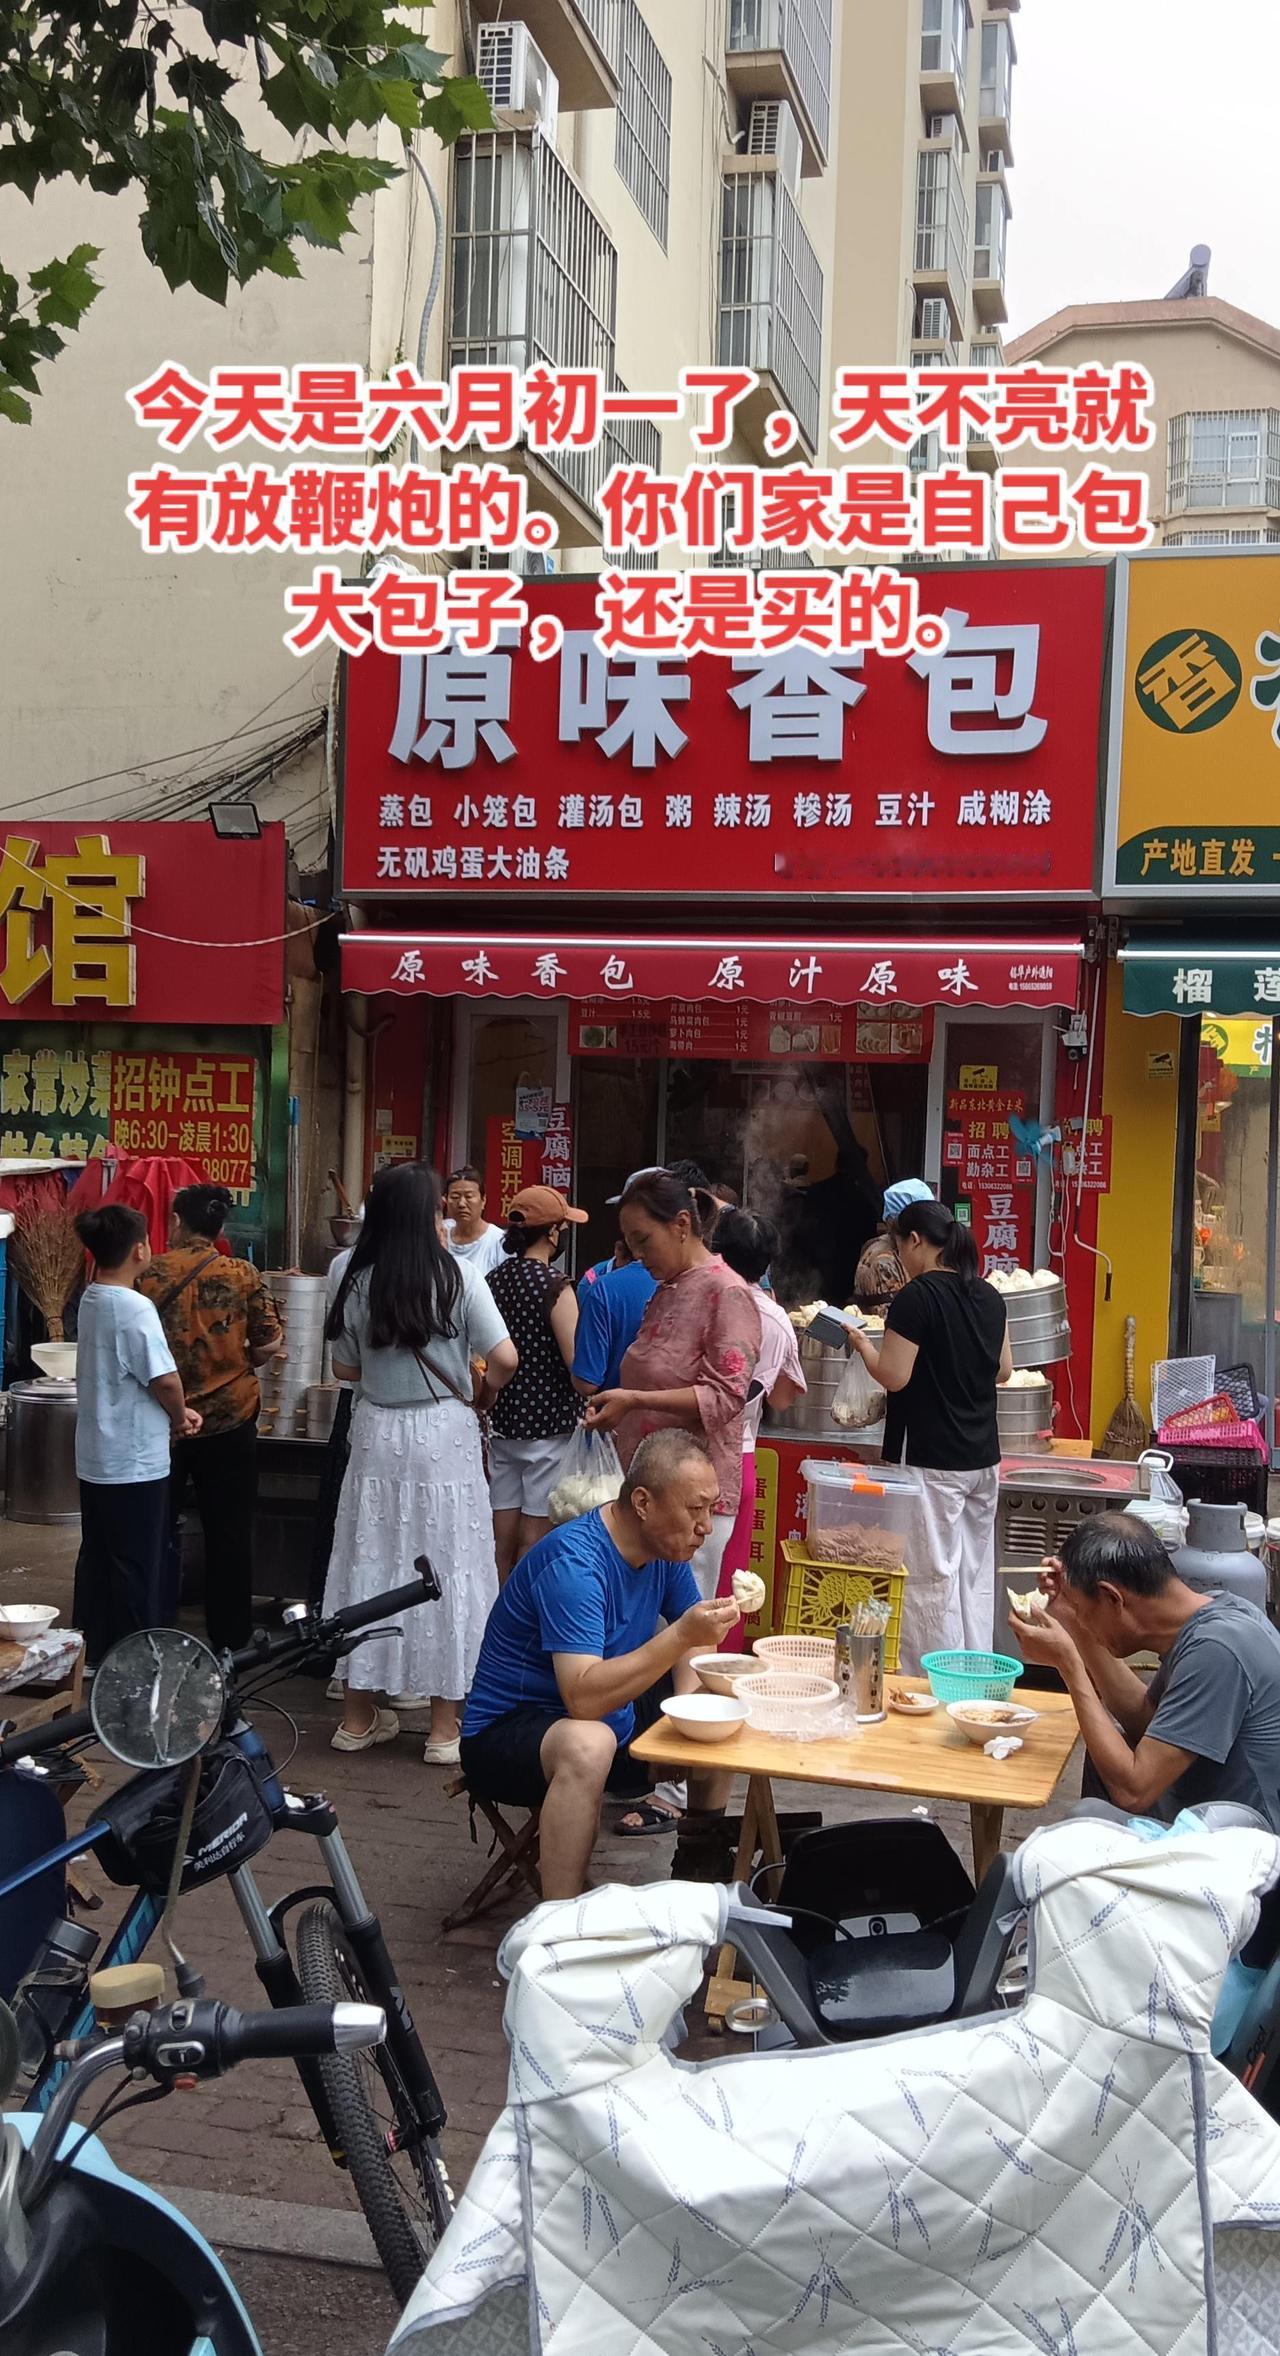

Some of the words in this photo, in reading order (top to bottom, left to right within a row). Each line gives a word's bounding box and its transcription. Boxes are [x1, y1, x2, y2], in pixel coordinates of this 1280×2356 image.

[386, 606, 1048, 768] 原味香包
[379, 794, 433, 828] 蒸包
[453, 794, 537, 828] 小笼包
[558, 794, 643, 828] 灌汤包
[665, 794, 692, 828] 粥
[713, 792, 772, 828] 辣汤
[875, 790, 935, 827] 豆汁
[956, 788, 1051, 827] 咸糊涂
[376, 845, 570, 881] 无矾鸡蛋大油条
[1140, 838, 1256, 877] 产地直发
[0, 834, 146, 1006] 馆
[390, 950, 634, 990] 原味香包
[707, 955, 979, 996] 原汁原味
[113, 1056, 250, 1113] 招钟点工
[968, 1121, 1010, 1140] 招聘
[966, 1161, 1008, 1178] 勤杂工
[967, 1143, 1009, 1160] 面点工
[198, 1811, 248, 1856] MERIDA
